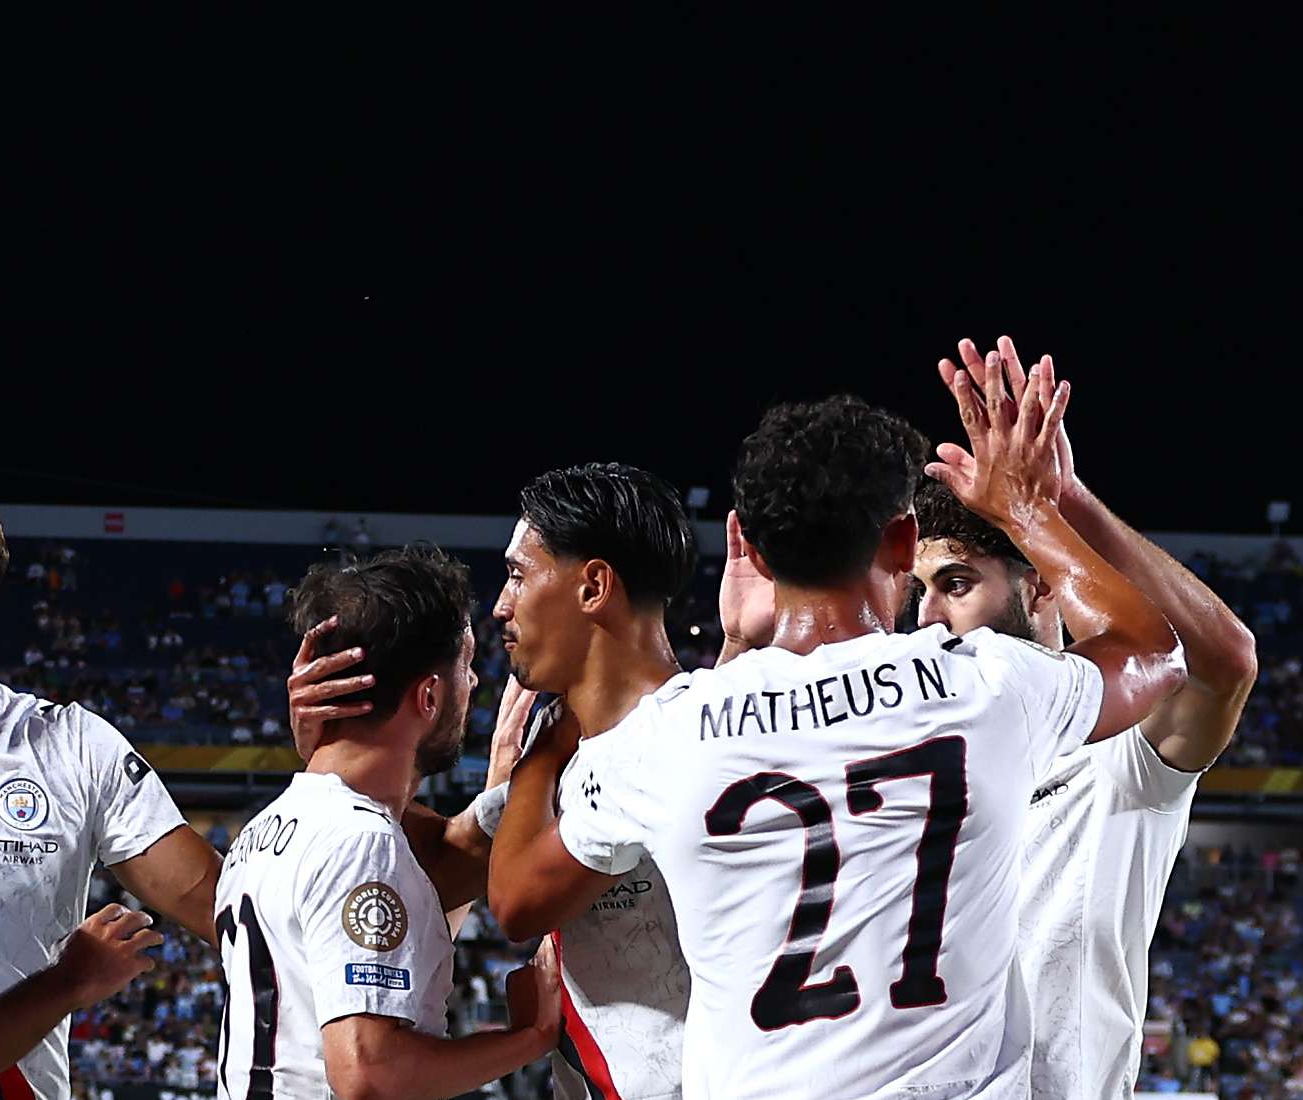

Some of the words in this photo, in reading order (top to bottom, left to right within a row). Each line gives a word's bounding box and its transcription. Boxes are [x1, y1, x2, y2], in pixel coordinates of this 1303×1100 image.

[700, 663, 904, 741] MATHEUS
[911, 657, 958, 701] N.
[704, 735, 969, 1032] 27
[350, 888, 380, 910] WORLD
[348, 911, 362, 935] CLUB
[364, 934, 389, 947] FIFA
